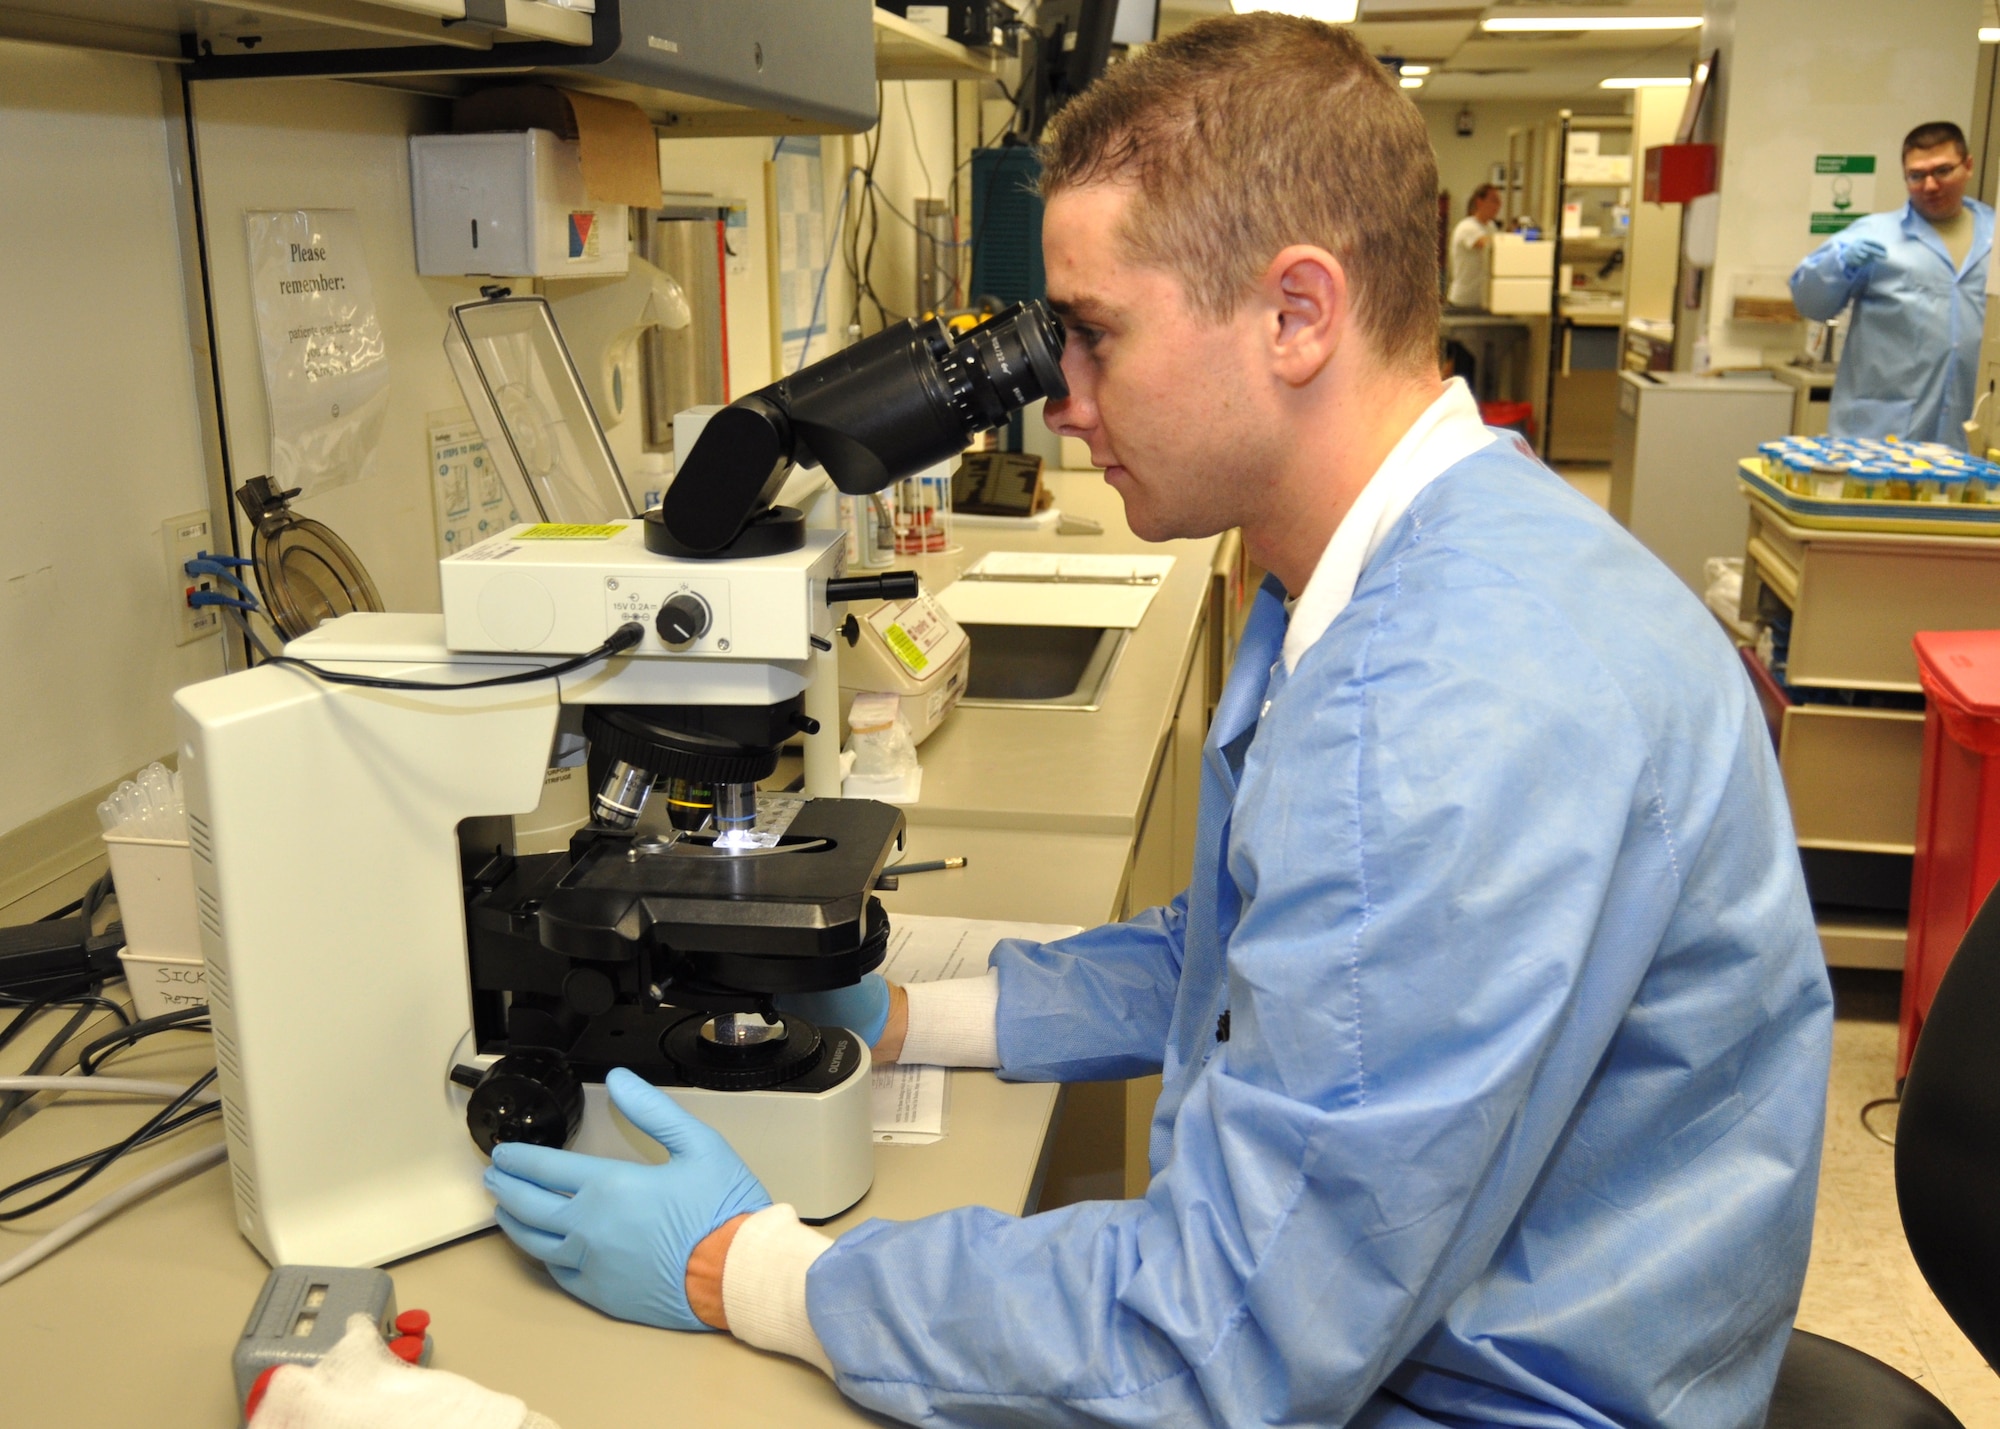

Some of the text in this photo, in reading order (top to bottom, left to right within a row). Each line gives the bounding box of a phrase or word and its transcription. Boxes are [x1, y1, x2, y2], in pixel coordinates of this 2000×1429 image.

[290, 243, 326, 262] Please
[279, 273, 345, 294] remember:
[156, 968, 207, 984] SICK
[828, 1040, 848, 1073] OLYMPUS
